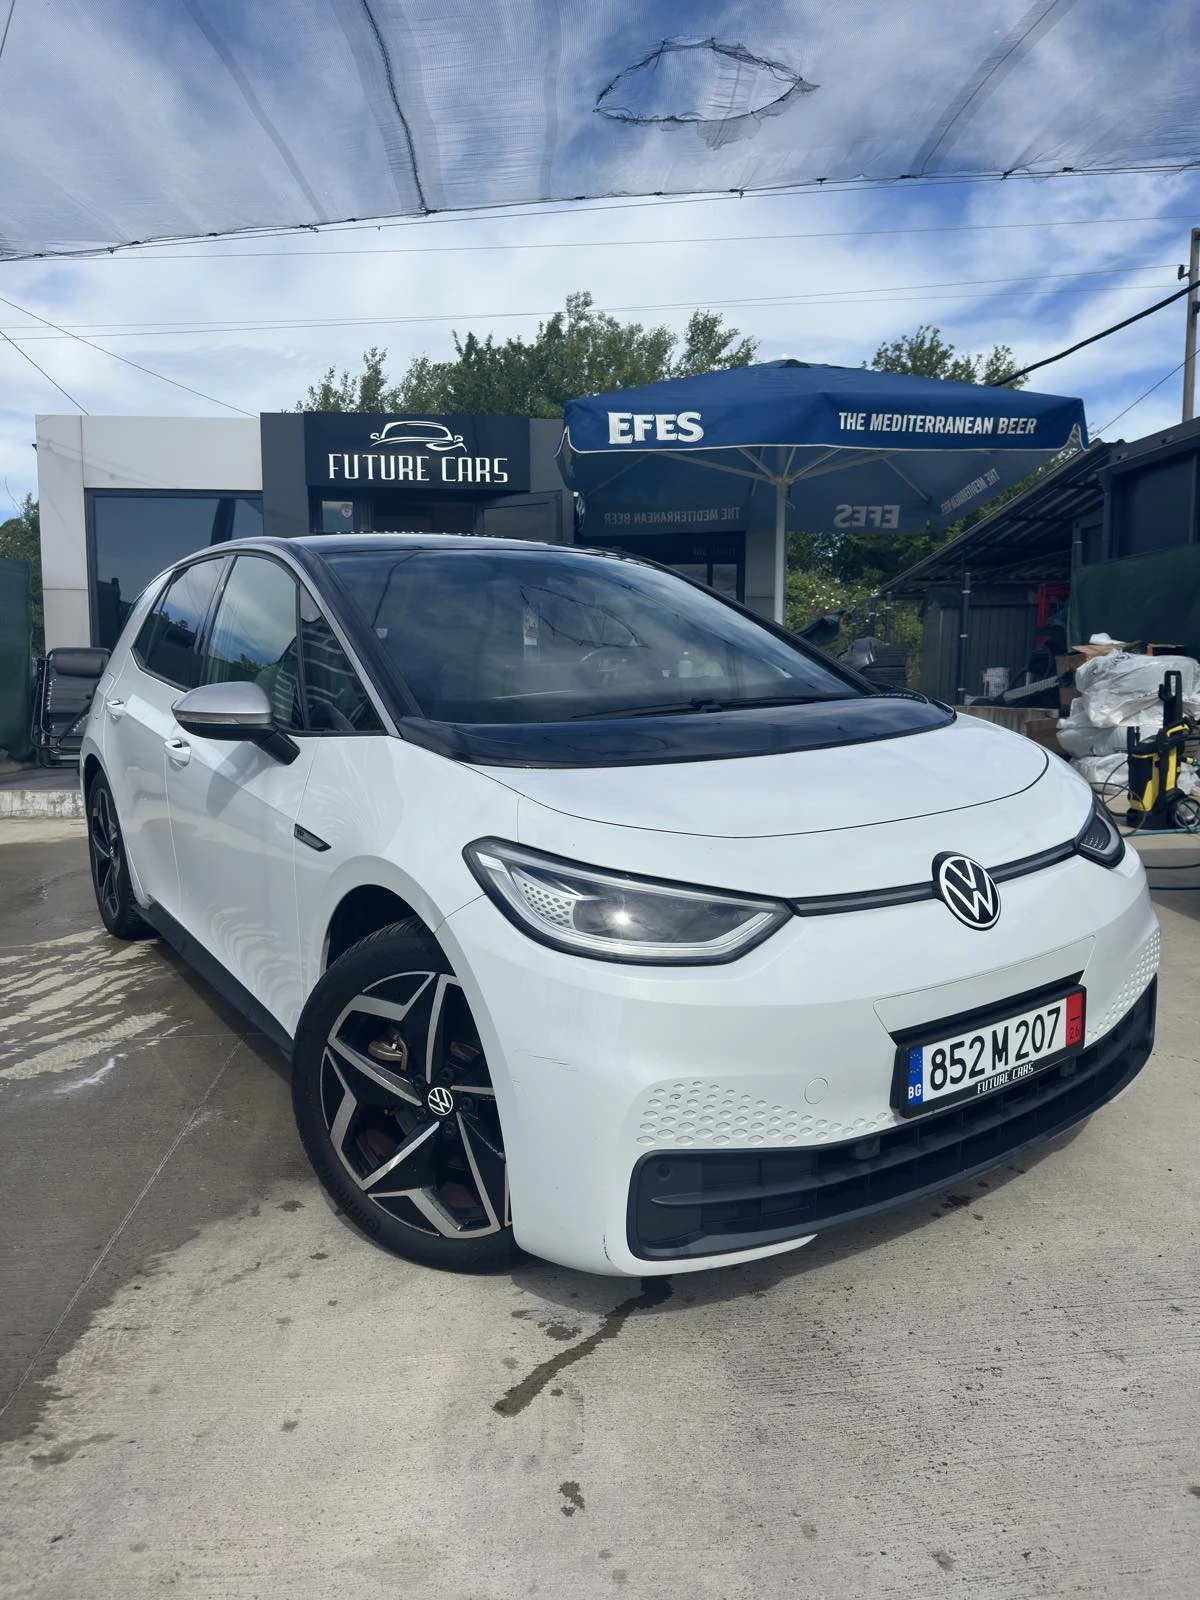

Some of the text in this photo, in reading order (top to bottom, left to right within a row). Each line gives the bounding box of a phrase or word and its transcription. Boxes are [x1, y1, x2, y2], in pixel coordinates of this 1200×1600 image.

[608, 411, 704, 444] EFES
[839, 412, 1036, 435] THE MEDITERRANEAN BEER
[328, 453, 508, 483] FUTURE CARS
[908, 1083, 922, 1100] BG
[977, 1061, 1035, 1094] FUTURE CARS
